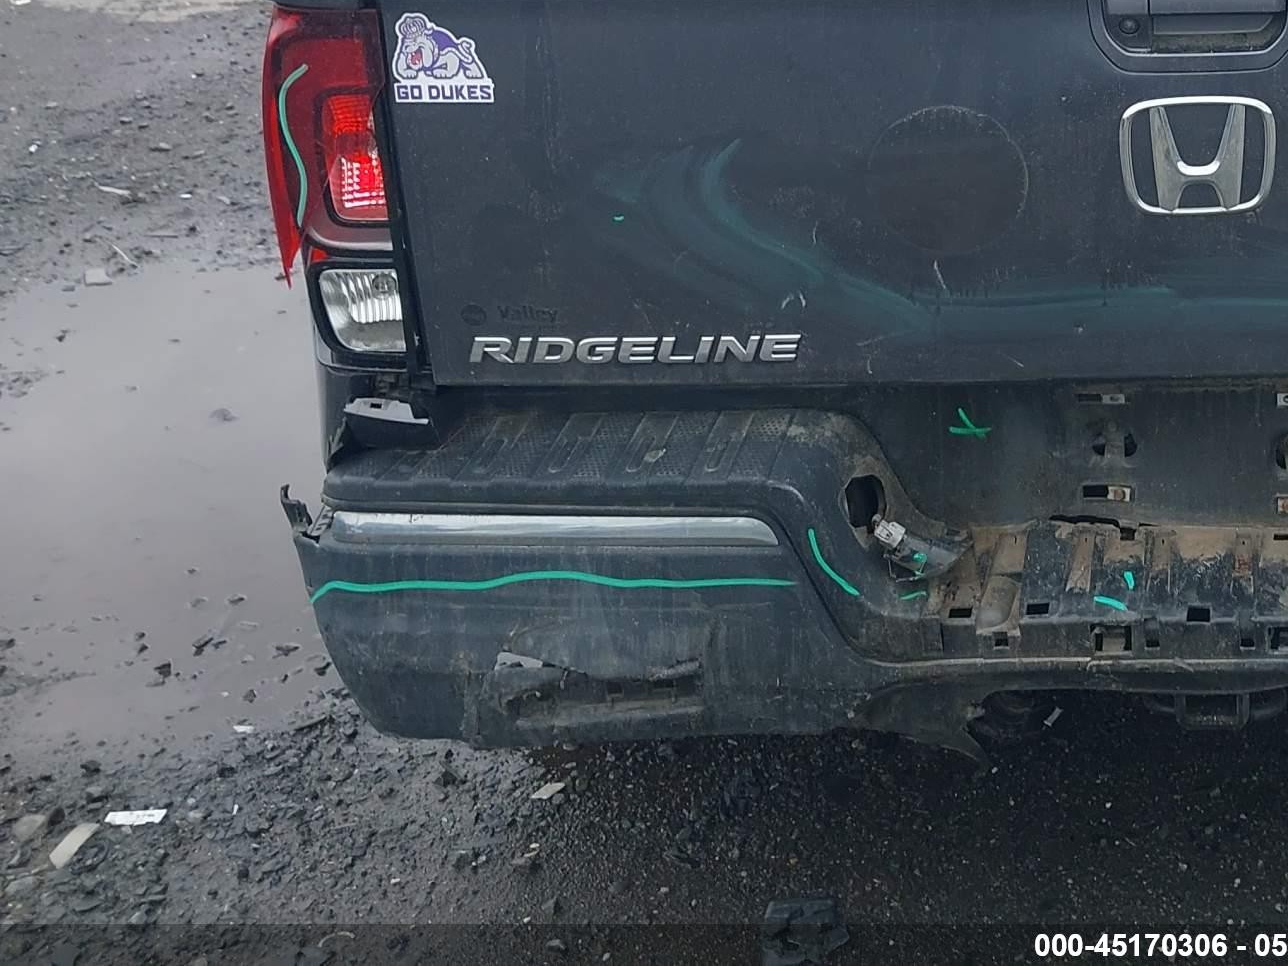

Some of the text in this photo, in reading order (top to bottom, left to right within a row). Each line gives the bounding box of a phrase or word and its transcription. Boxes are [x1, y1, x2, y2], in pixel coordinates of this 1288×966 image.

[396, 84, 492, 100] GO DUKES
[469, 334, 801, 364] RIDGELINE
